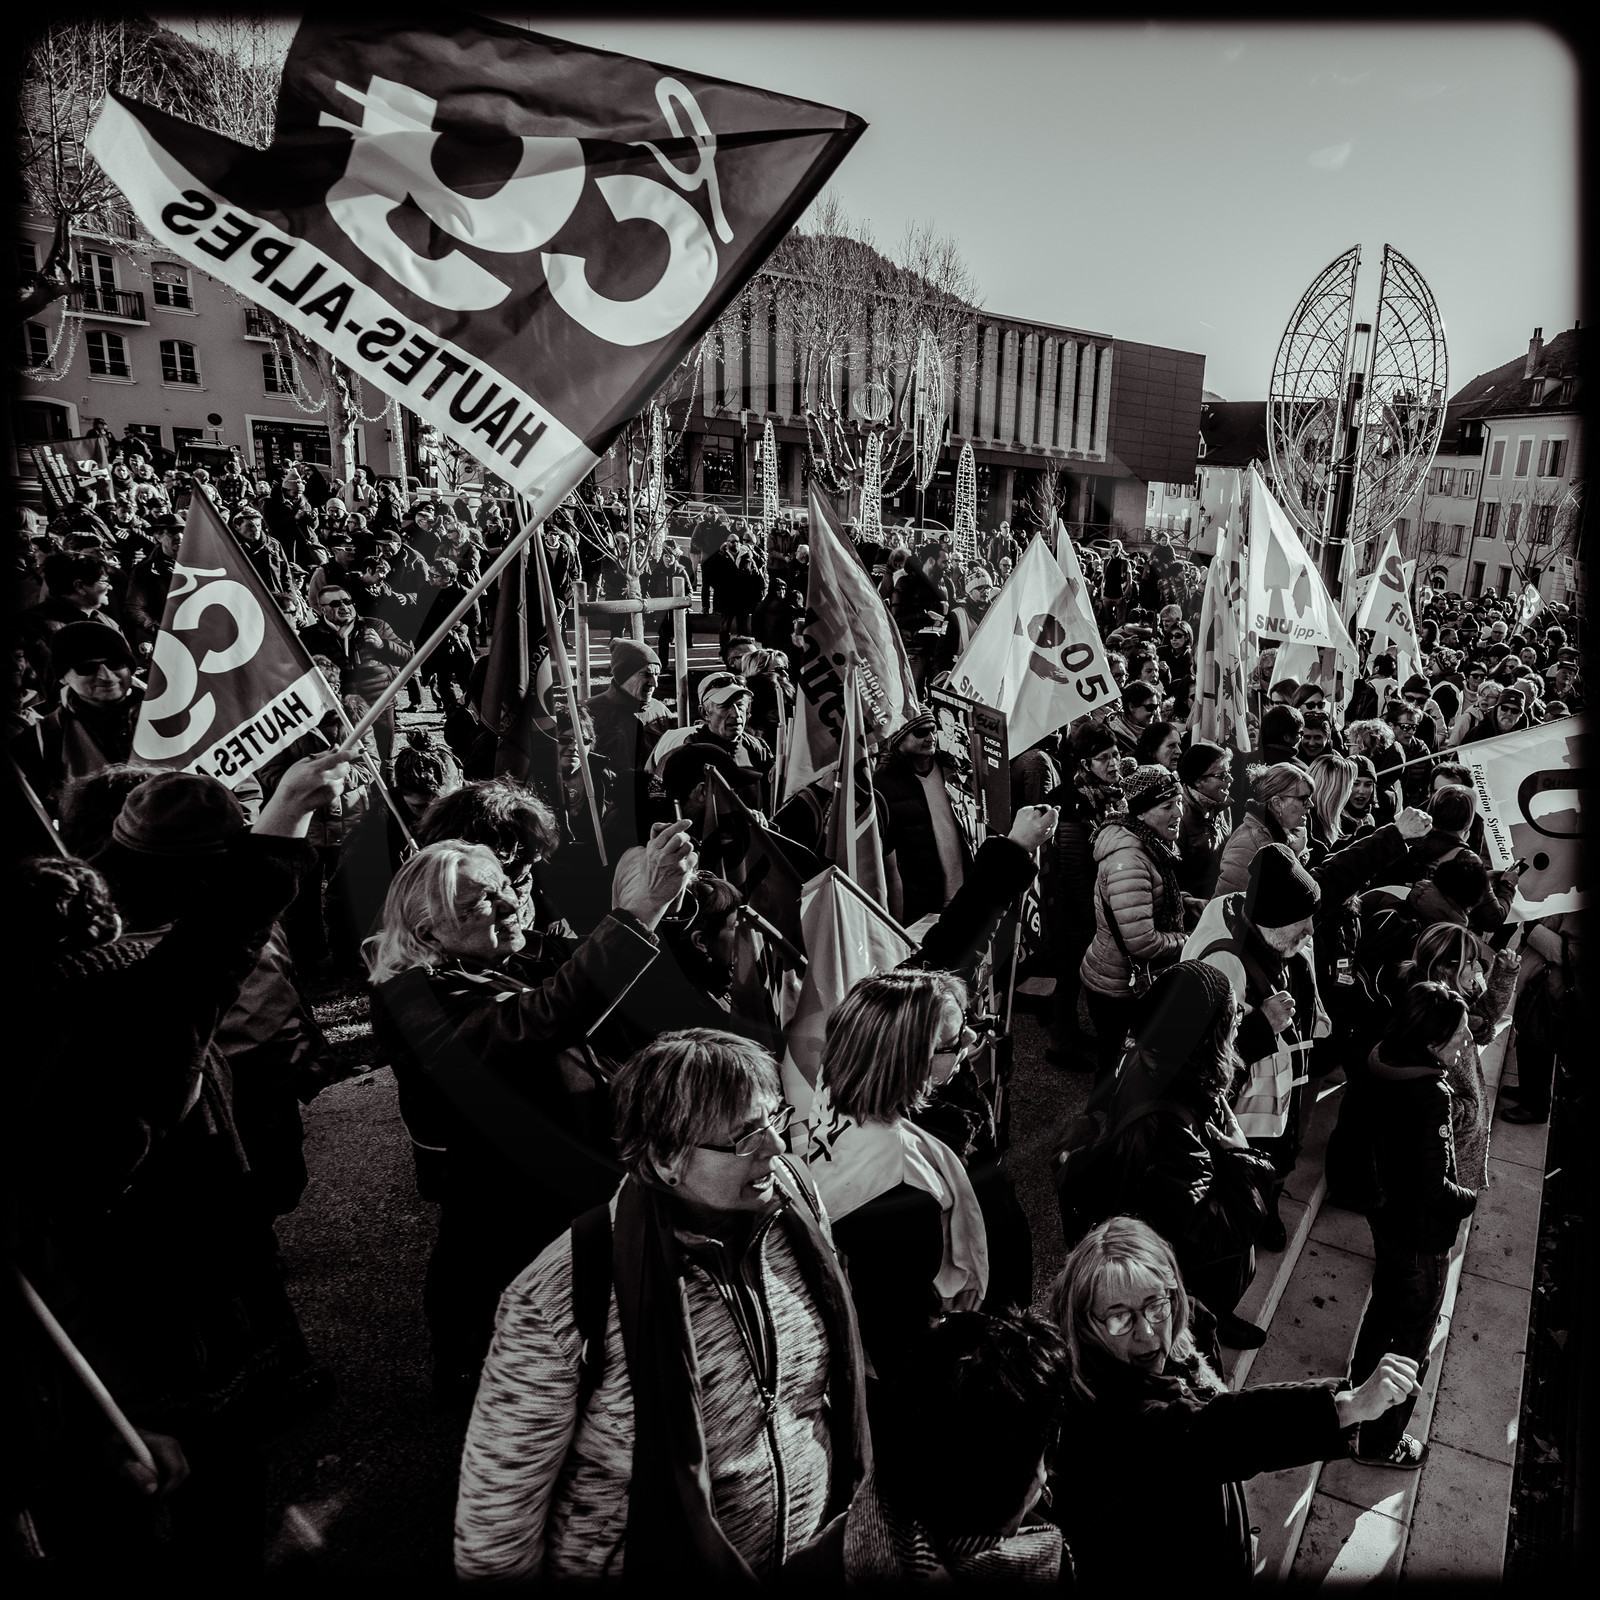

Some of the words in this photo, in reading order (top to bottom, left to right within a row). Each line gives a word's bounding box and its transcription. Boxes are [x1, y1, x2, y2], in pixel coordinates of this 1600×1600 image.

[1060, 642, 1110, 703] 05
[1471, 763, 1492, 813] Fédération
[1487, 817, 1510, 862] Syndicale
